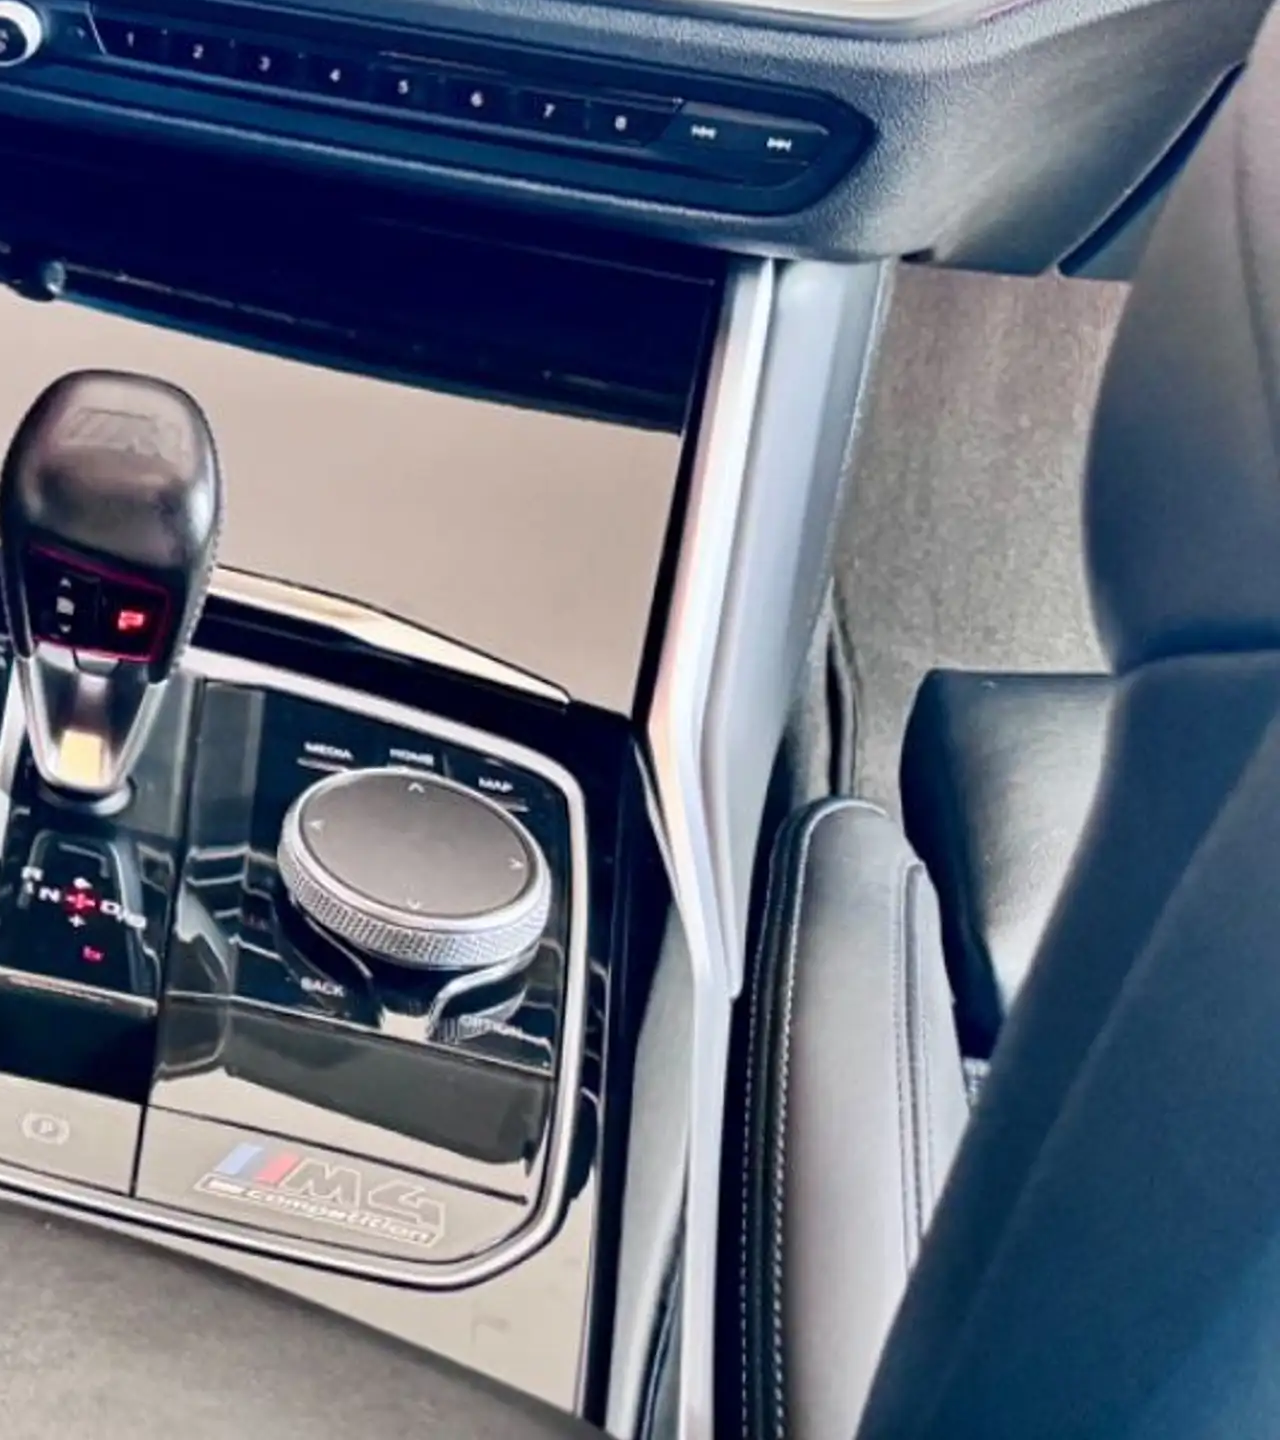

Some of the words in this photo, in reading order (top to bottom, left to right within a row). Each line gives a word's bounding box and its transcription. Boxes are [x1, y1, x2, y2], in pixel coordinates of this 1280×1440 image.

[192, 43, 205, 60] 2
[300, 976, 346, 997] BACK
[278, 1157, 446, 1232] M4
